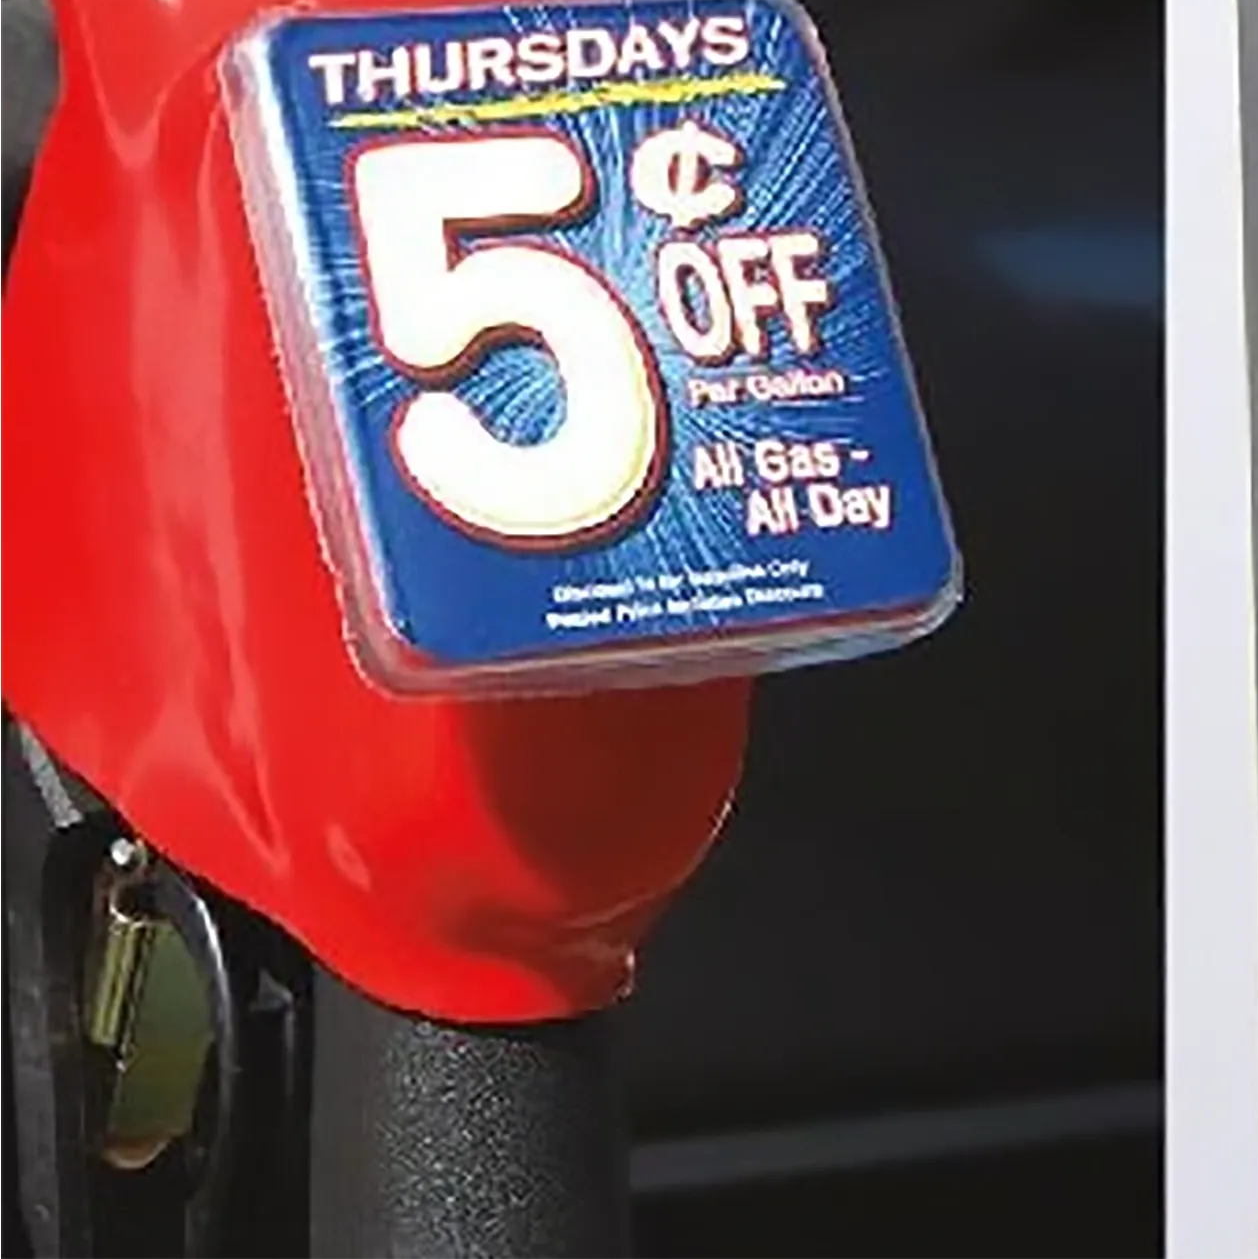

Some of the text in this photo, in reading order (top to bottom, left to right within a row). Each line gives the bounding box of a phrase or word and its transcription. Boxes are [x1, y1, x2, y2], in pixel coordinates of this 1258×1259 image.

[309, 17, 750, 107] THURSDAYS
[656, 229, 831, 362] OFF
[746, 367, 846, 401] Gallon
[693, 440, 745, 490] All
[754, 438, 841, 483] Gas
[746, 483, 891, 536] All Day
